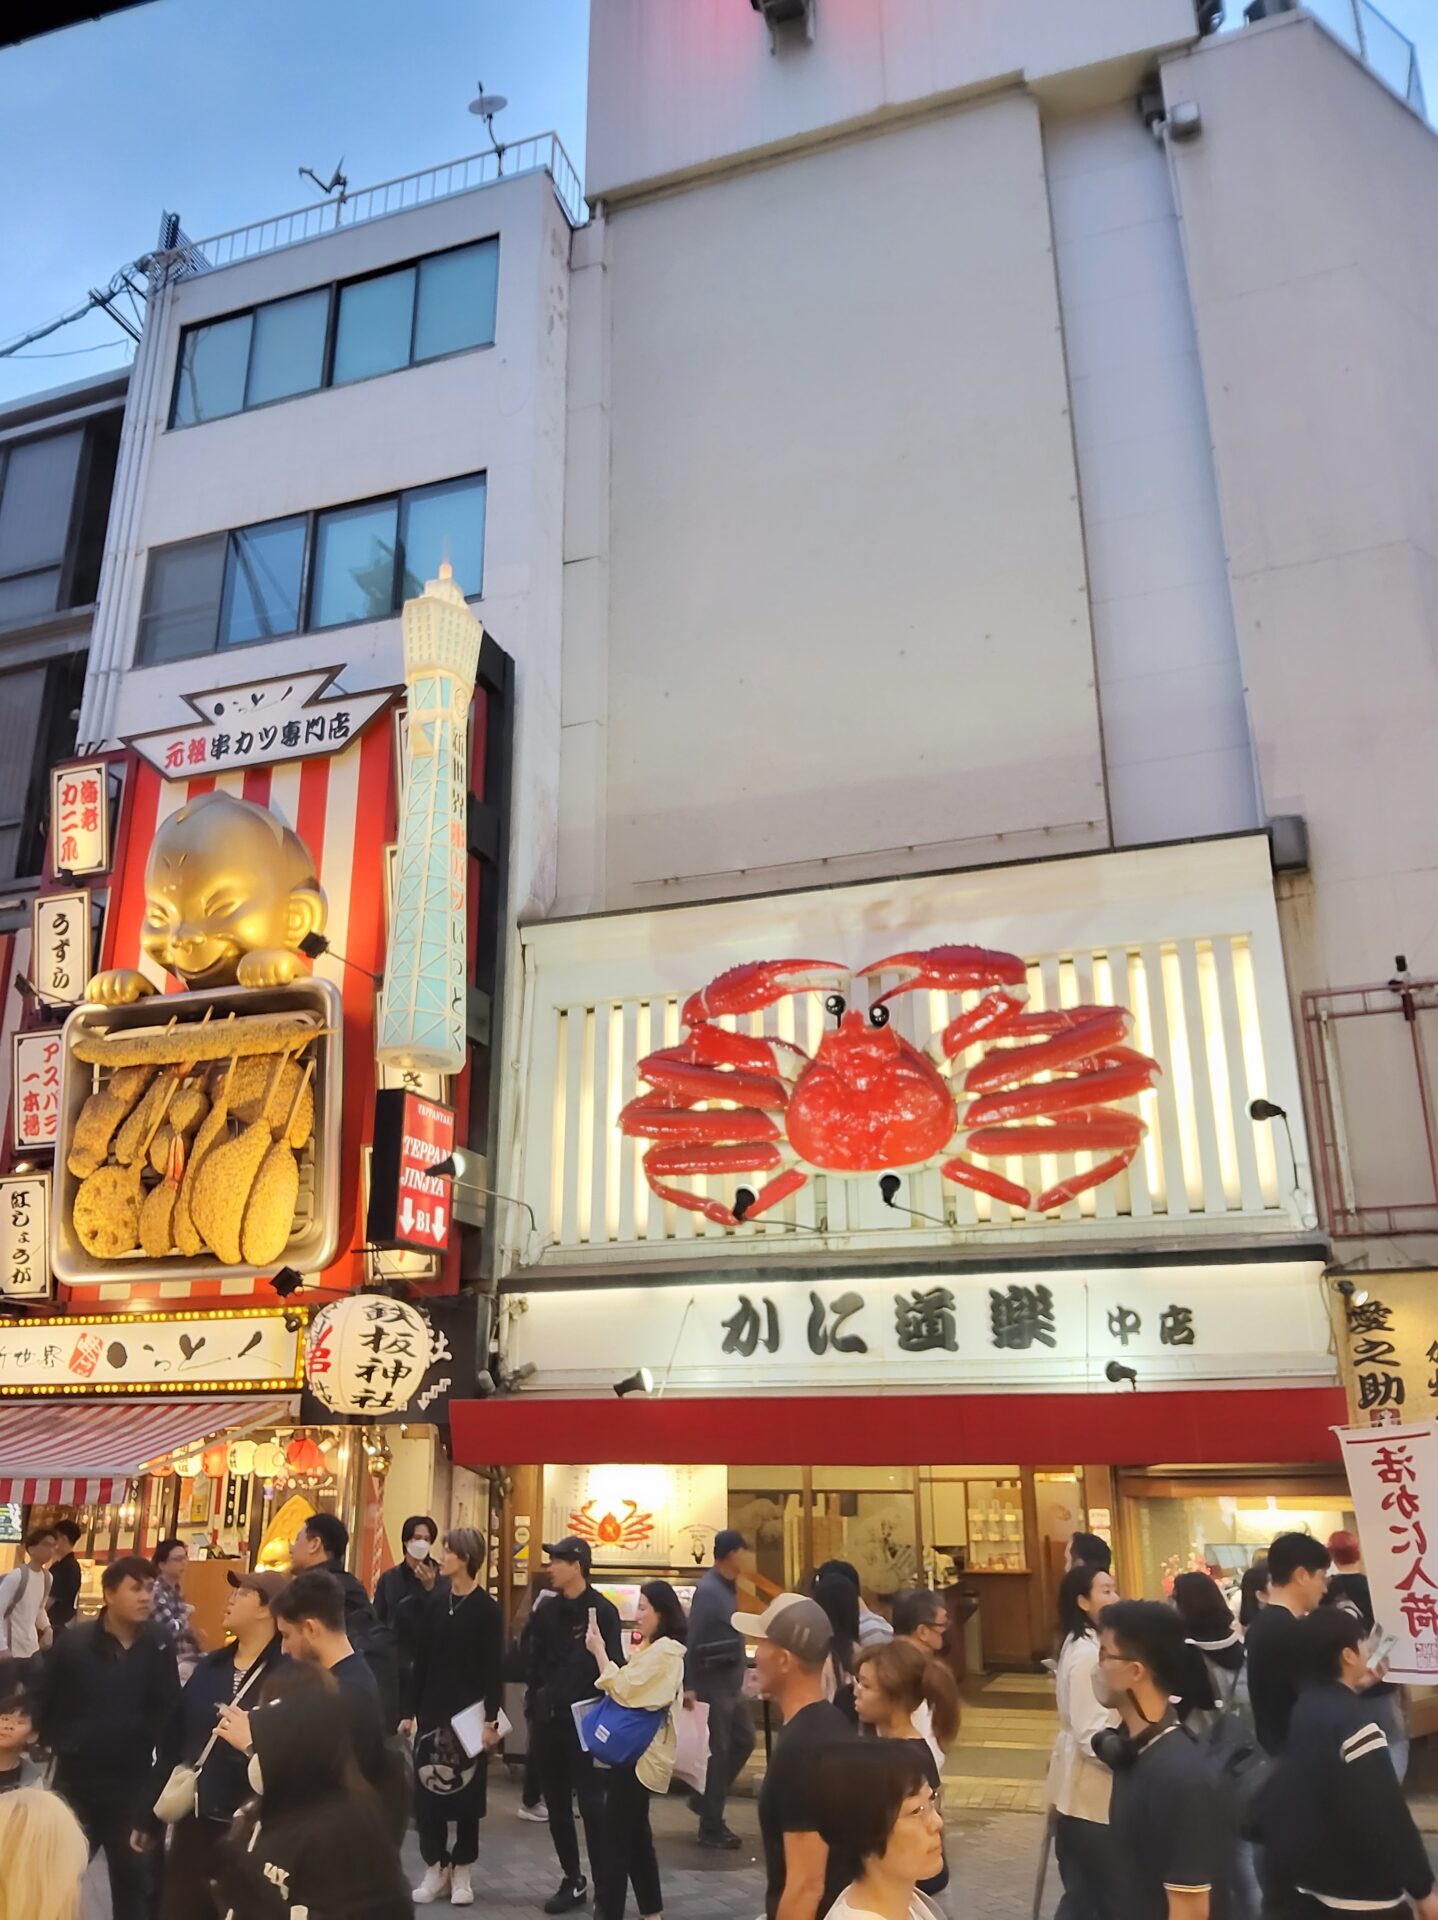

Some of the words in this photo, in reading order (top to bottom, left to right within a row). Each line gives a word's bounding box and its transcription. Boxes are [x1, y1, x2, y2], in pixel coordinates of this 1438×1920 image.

[52, 912, 71, 990] うずら
[400, 1166, 445, 1198] JINJYA
[415, 1209, 431, 1234] B1
[1106, 1304, 1195, 1346] 中店
[350, 1301, 420, 1409] 鉄板神社
